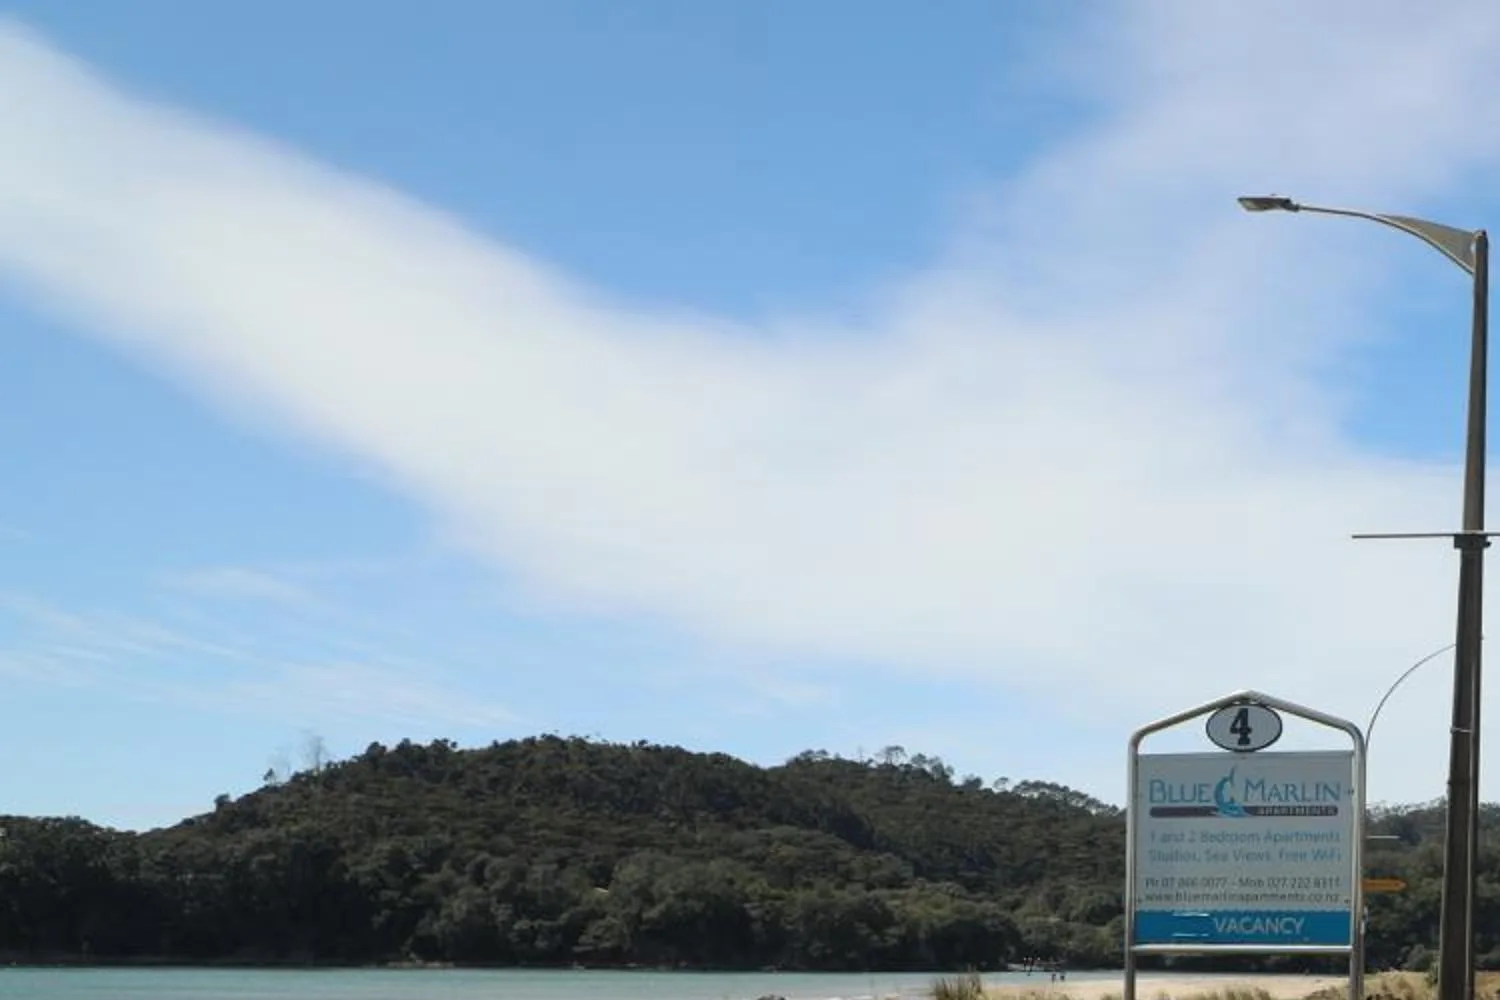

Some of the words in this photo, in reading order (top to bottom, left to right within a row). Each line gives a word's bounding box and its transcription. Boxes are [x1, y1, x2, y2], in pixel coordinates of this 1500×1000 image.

[1229, 707, 1252, 746] 4
[1149, 778, 1211, 803] BLUE
[1243, 777, 1341, 802] MARLIN
[1159, 830, 1185, 844] and
[1187, 829, 1197, 843] 2
[1200, 829, 1260, 844] Bedroom
[1263, 828, 1340, 846] Apartments
[1204, 848, 1229, 863] Sea
[1278, 848, 1307, 862] Free
[1213, 916, 1304, 934] VACANCY
